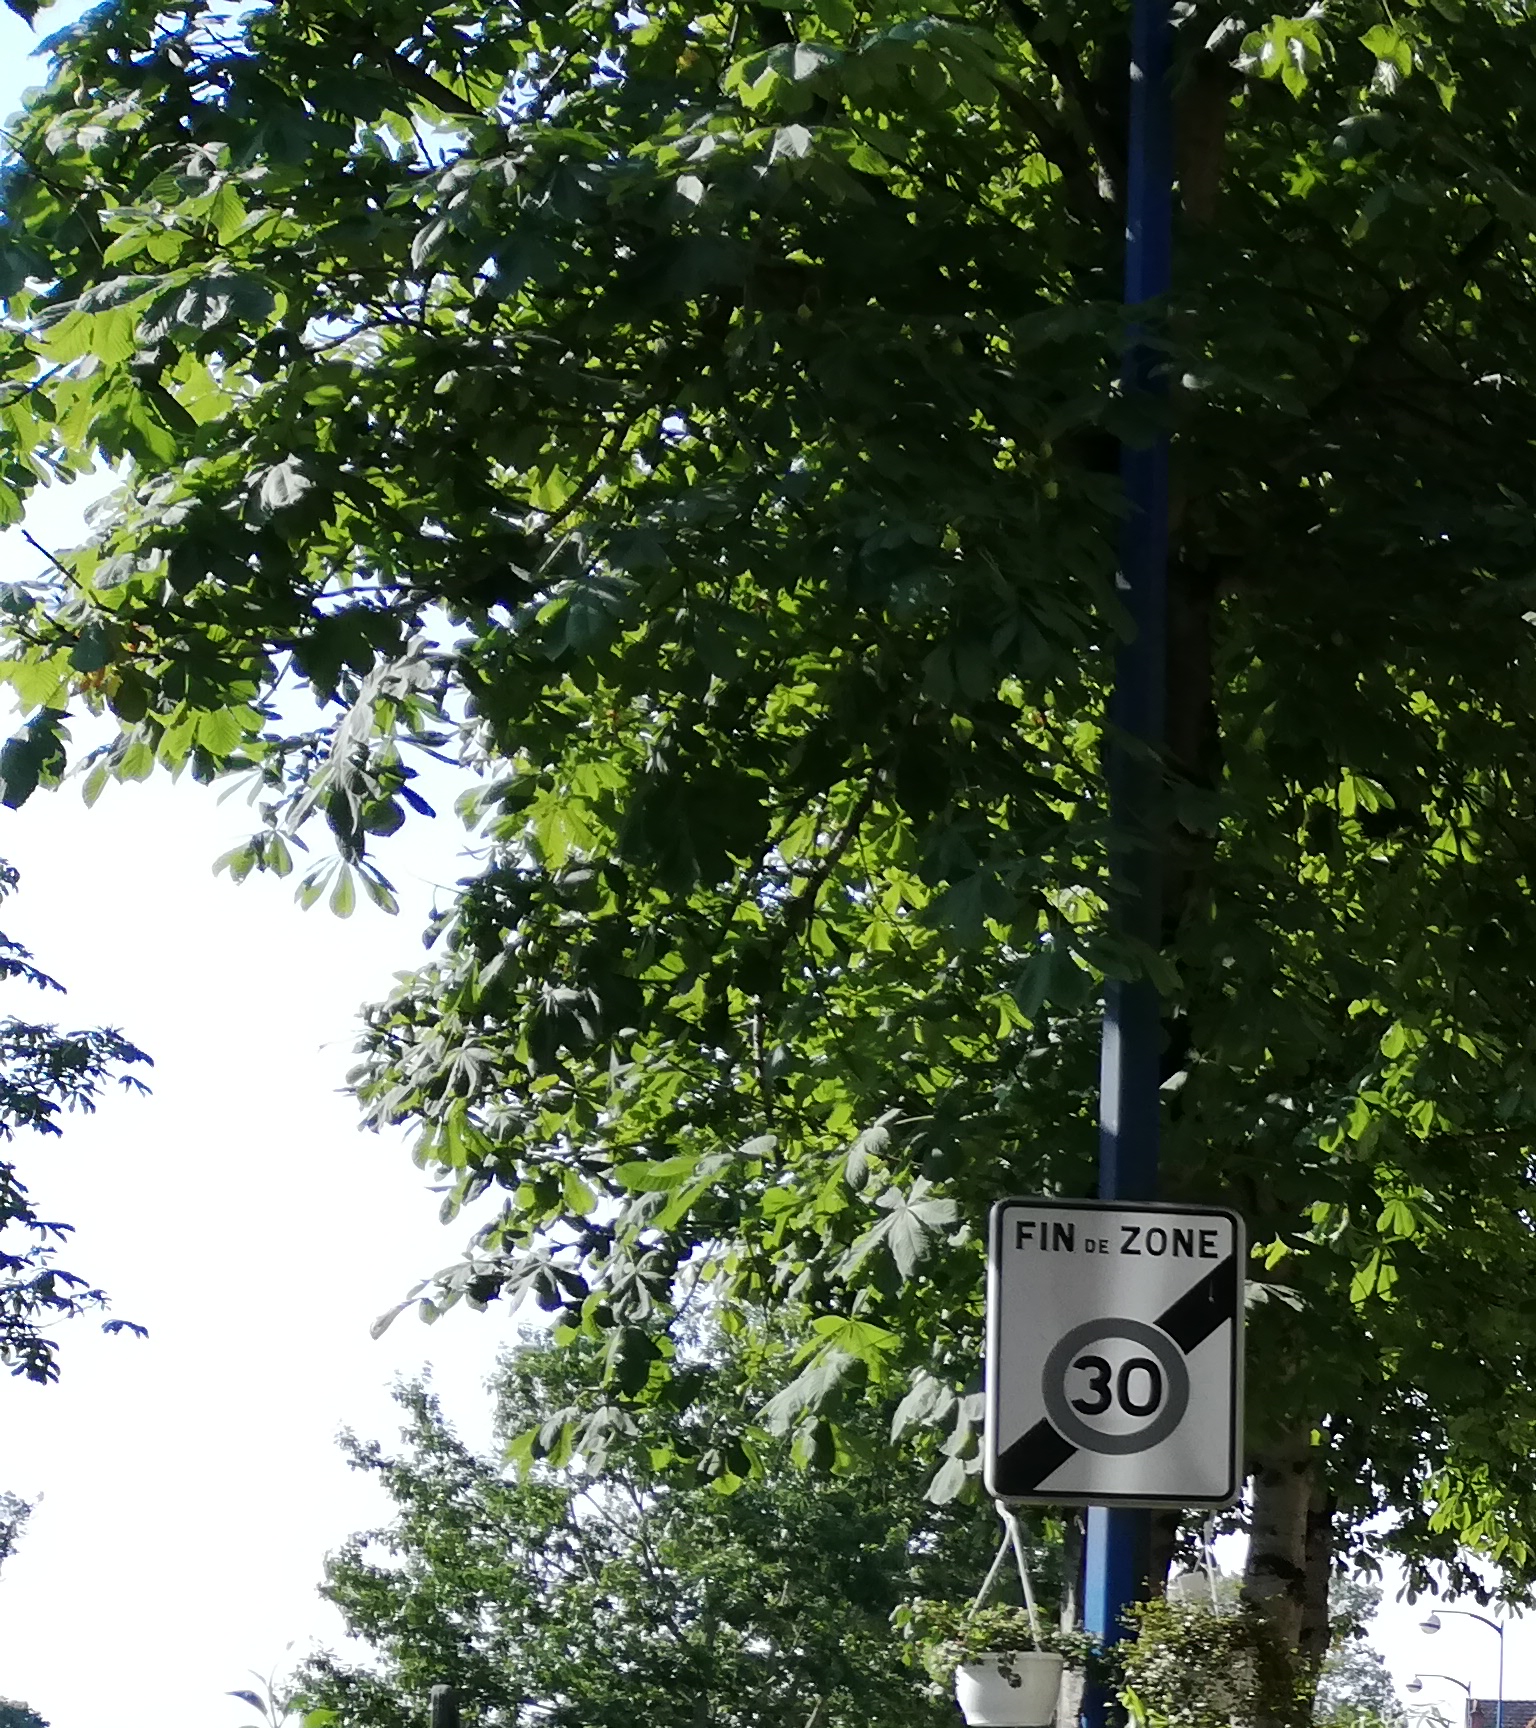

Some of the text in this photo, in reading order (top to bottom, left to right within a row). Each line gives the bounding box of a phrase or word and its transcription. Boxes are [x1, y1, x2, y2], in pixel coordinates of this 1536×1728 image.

[1015, 1220, 1076, 1253] FIN
[1120, 1224, 1220, 1260] ZONE
[1070, 1354, 1163, 1418] 30
